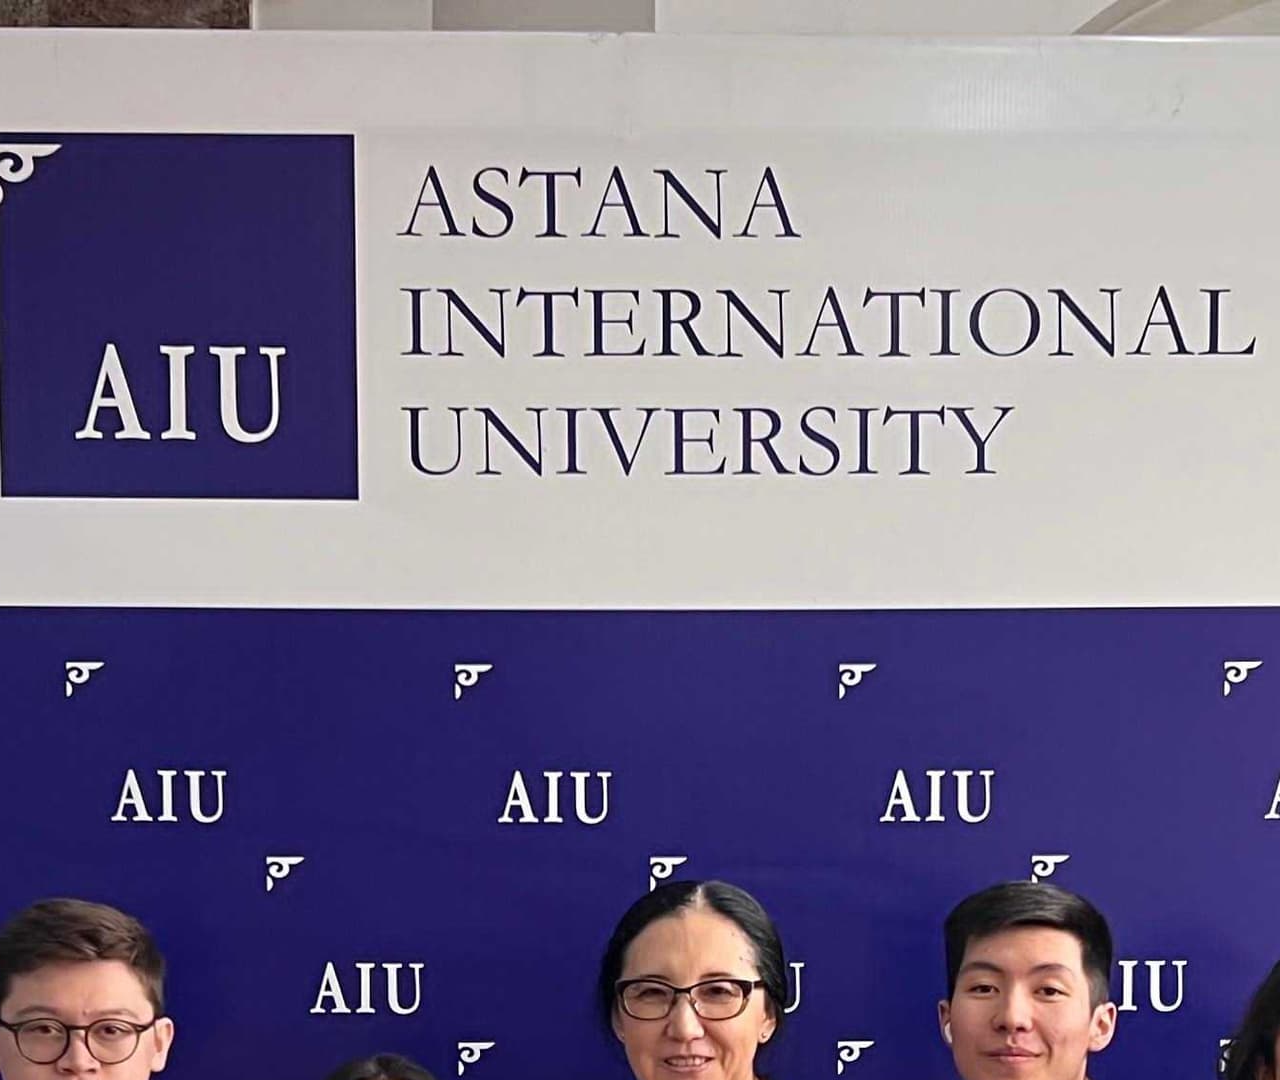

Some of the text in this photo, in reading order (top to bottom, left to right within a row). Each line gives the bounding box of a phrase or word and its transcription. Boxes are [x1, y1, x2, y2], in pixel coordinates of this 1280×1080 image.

[397, 165, 802, 240] ASTANA
[400, 285, 1258, 359] INTERNATIONAL
[75, 343, 287, 443] AIU
[402, 405, 1015, 477] UNIVERSITY
[110, 769, 227, 823] AIU
[497, 770, 612, 825] AIU
[879, 769, 995, 823] AIU
[309, 961, 425, 1015] AIU
[1117, 960, 1188, 1013] IU
